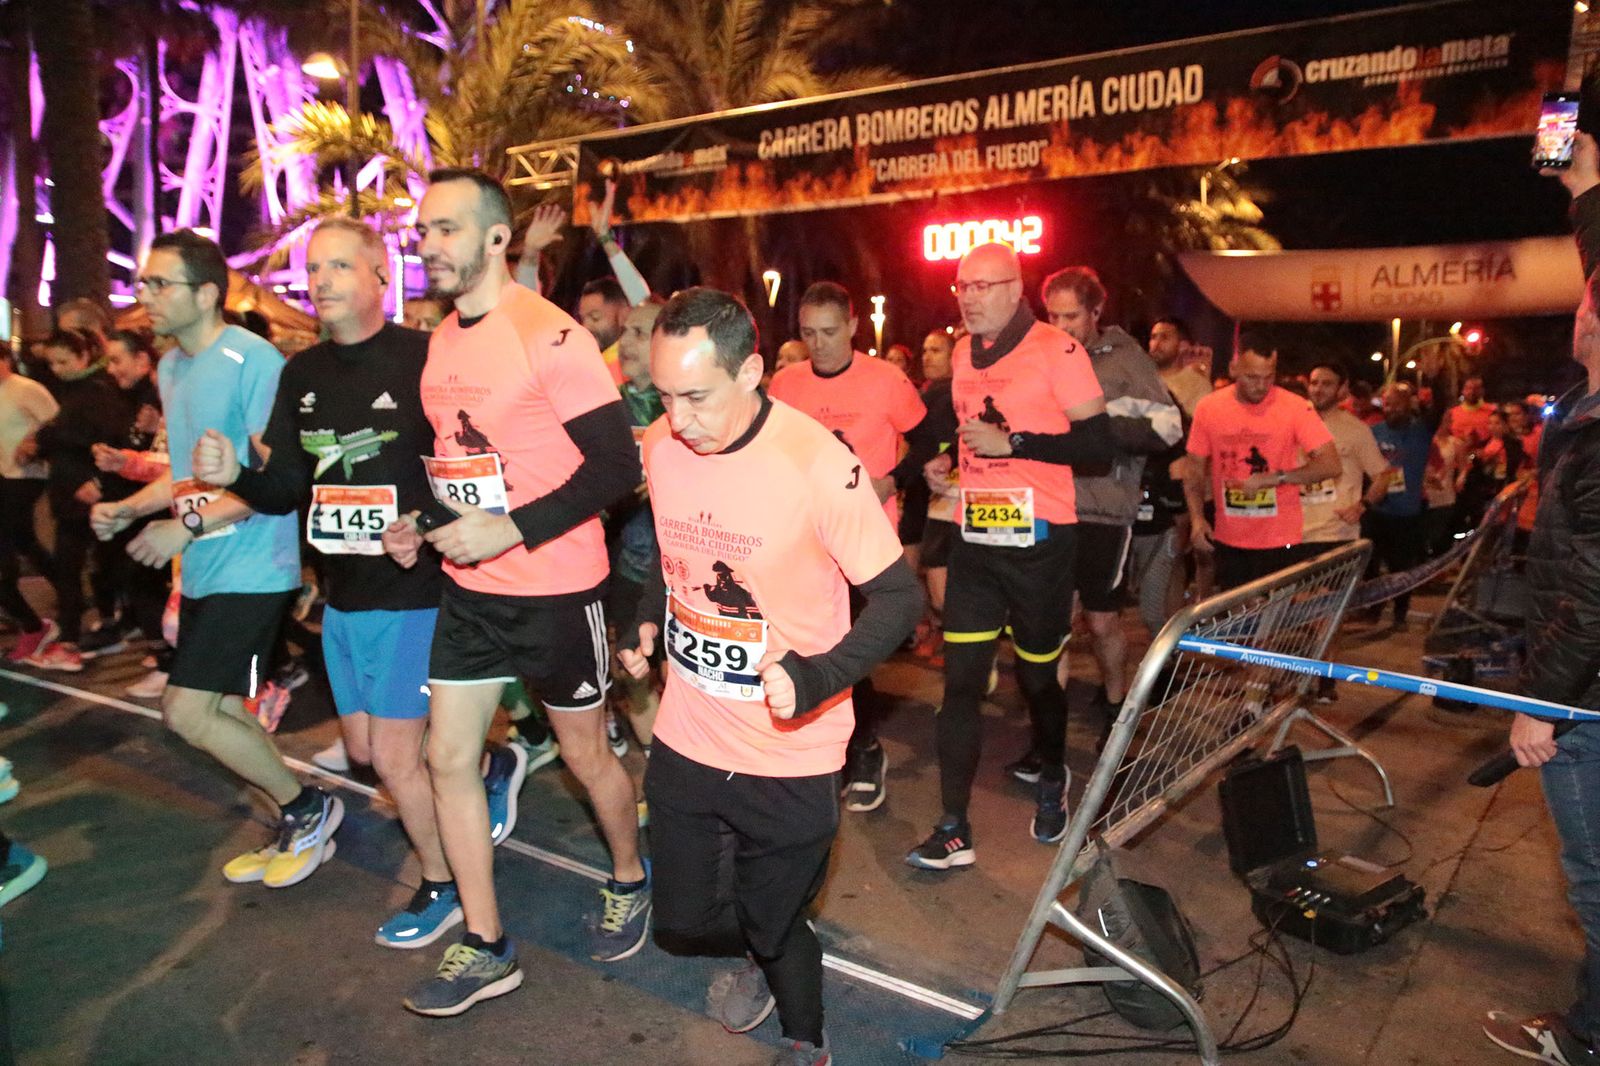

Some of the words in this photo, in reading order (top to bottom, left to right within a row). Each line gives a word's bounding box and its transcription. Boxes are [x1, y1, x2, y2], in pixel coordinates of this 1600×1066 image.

[758, 116, 853, 161] CARRERA
[855, 97, 980, 147] BOMBEROS
[983, 74, 1096, 130] ALMERÍA
[1101, 63, 1204, 116] CIUDAD
[869, 150, 950, 183] "CARRERA
[952, 148, 984, 174] DEL
[986, 139, 1049, 169] FUEGO"
[447, 483, 481, 506] 88
[330, 508, 385, 530] 145
[977, 508, 1022, 521] 2434
[660, 516, 699, 535] CARRERA
[701, 526, 763, 548] BOMBEROS
[708, 539, 752, 555] CIUDAD
[682, 631, 748, 672] 259
